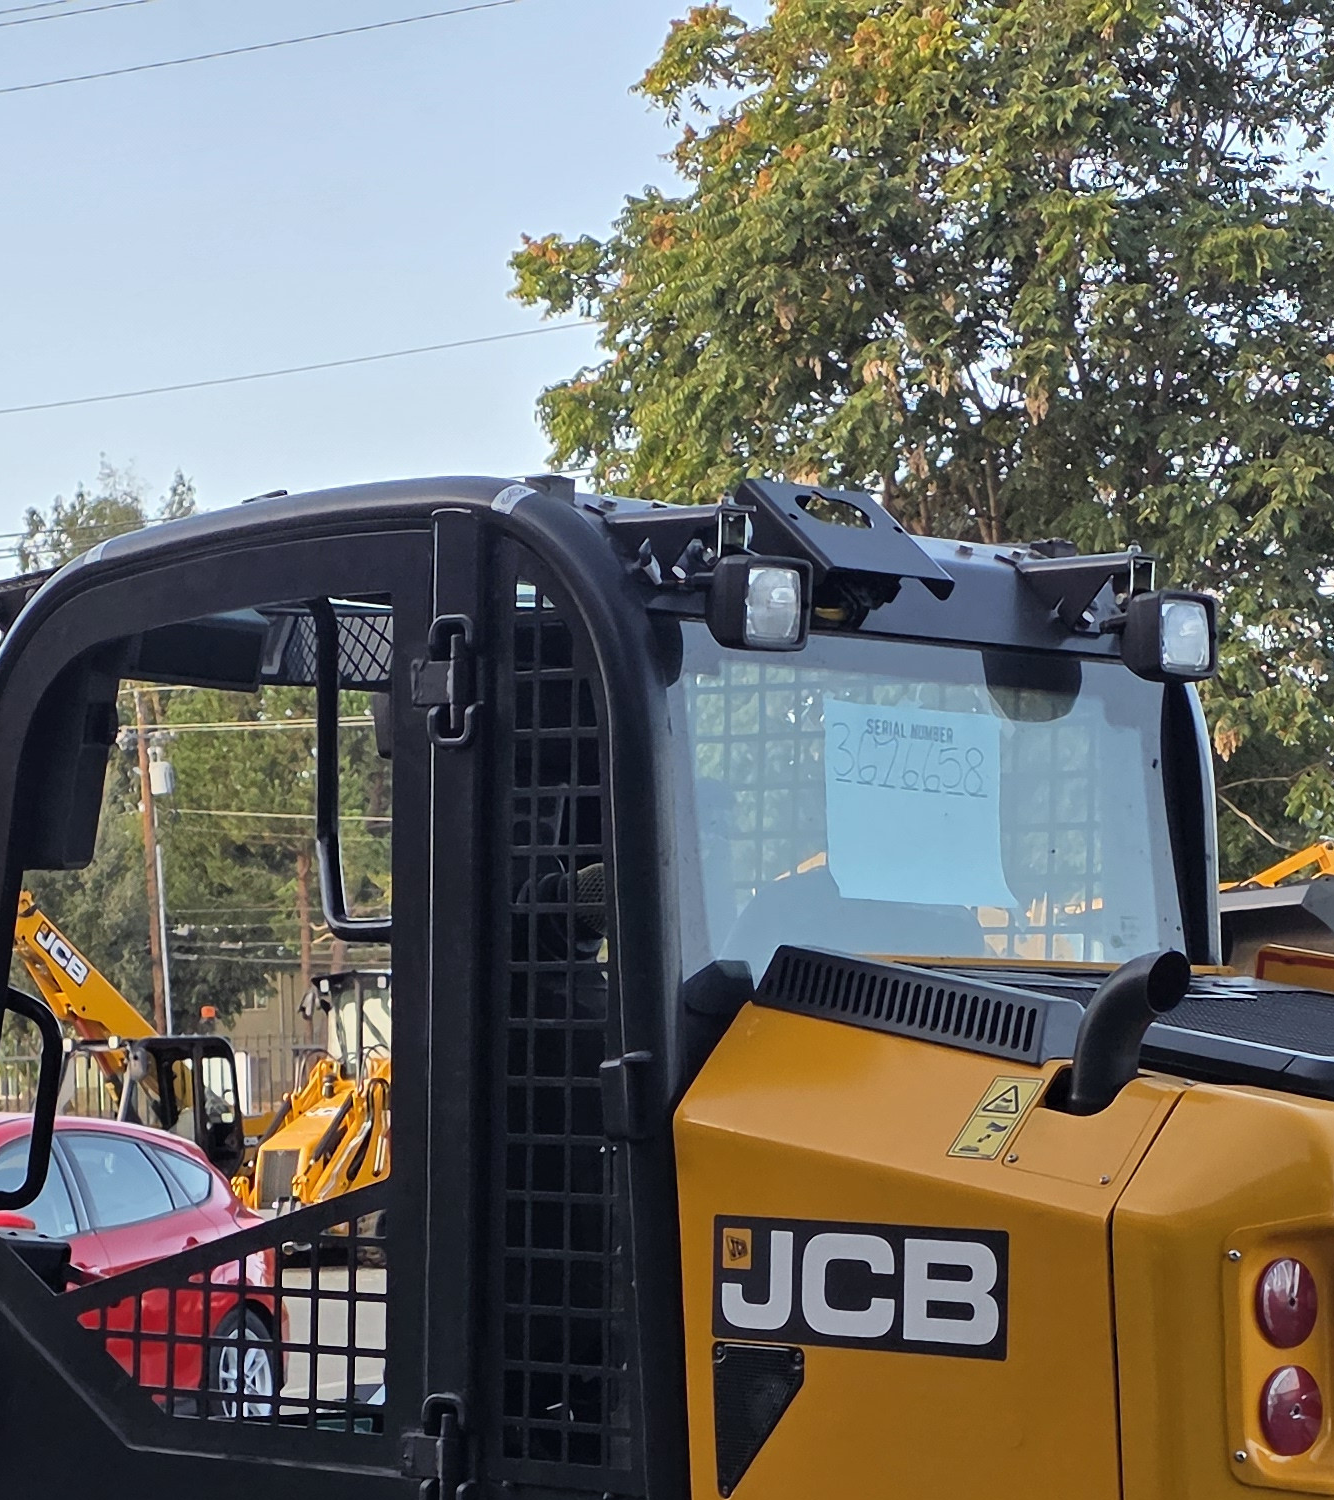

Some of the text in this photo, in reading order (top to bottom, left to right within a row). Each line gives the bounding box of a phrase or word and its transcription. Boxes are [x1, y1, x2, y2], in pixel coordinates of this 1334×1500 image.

[867, 718, 954, 744] SERIAL NUMBER
[35, 931, 88, 985] JCB
[721, 1230, 1000, 1346] JCB
